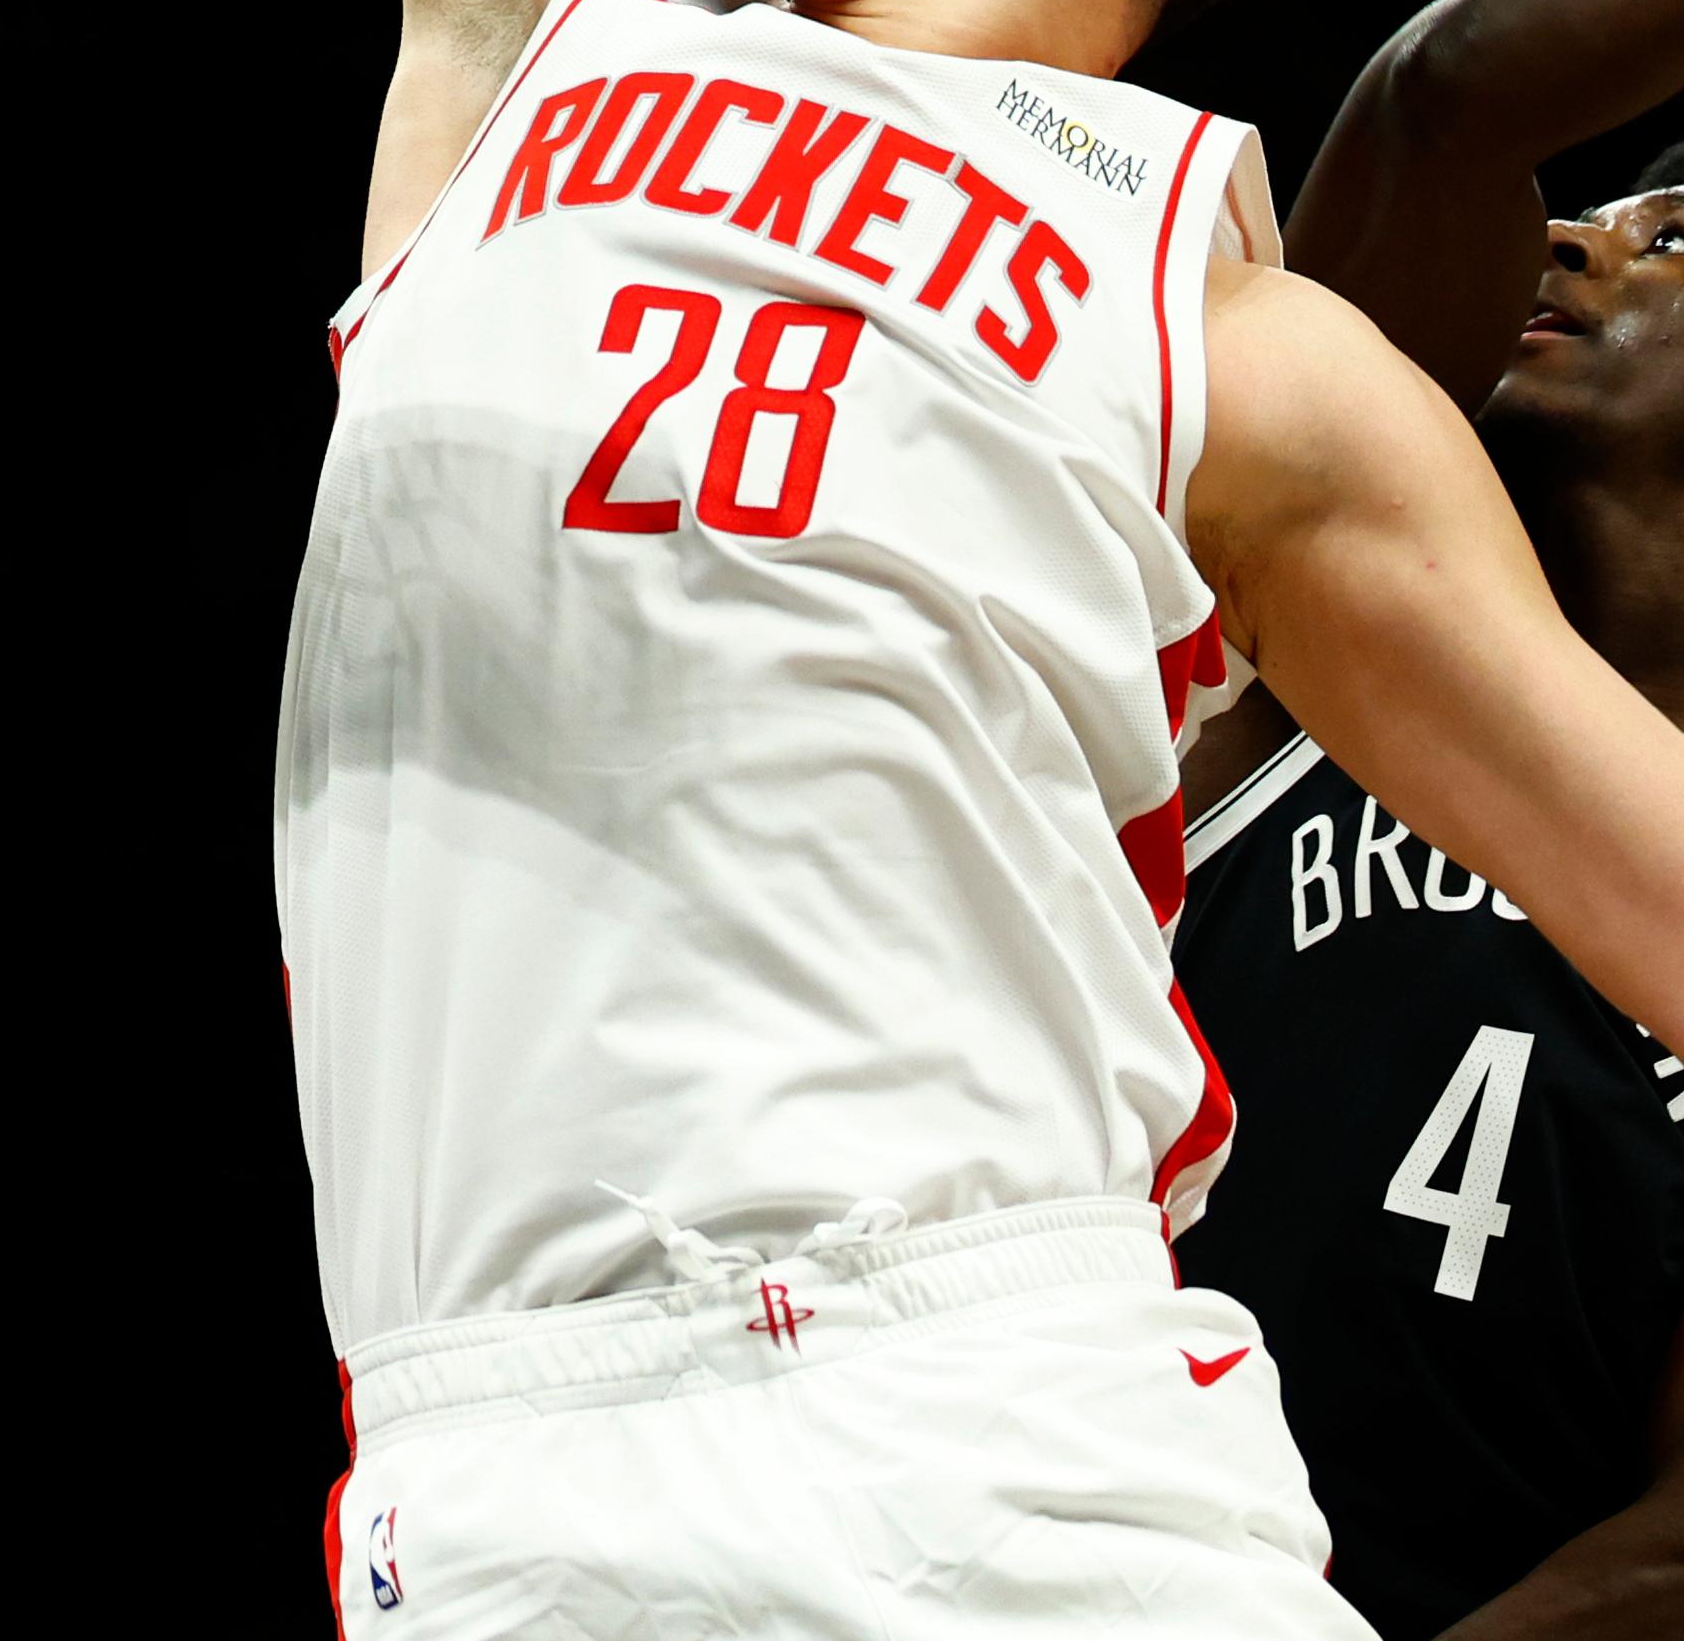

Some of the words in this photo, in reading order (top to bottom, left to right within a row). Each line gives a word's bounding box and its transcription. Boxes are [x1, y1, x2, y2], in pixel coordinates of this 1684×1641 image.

[477, 71, 1092, 386] ROCKETS
[996, 90, 1143, 196] HERMANN
[1004, 78, 1148, 180] MEMORIAL
[562, 284, 865, 538] 28
[1382, 1024, 1535, 1301] 4
